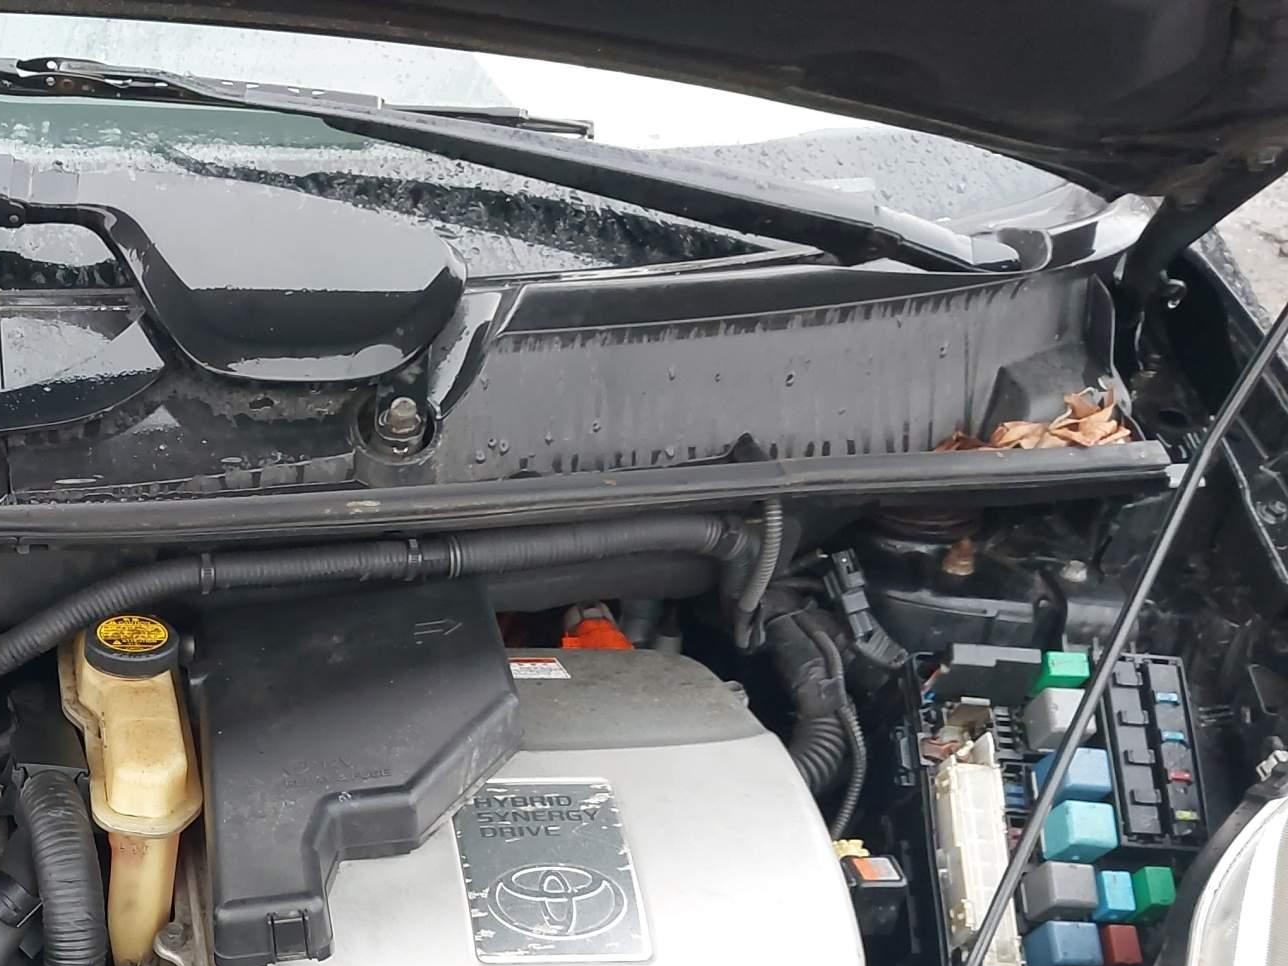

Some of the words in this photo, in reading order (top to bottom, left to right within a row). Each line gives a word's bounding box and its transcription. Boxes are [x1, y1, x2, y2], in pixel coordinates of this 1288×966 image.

[474, 795, 572, 809] HYBRID
[476, 809, 599, 823] SYNERGY
[479, 825, 561, 838] DRIVE
